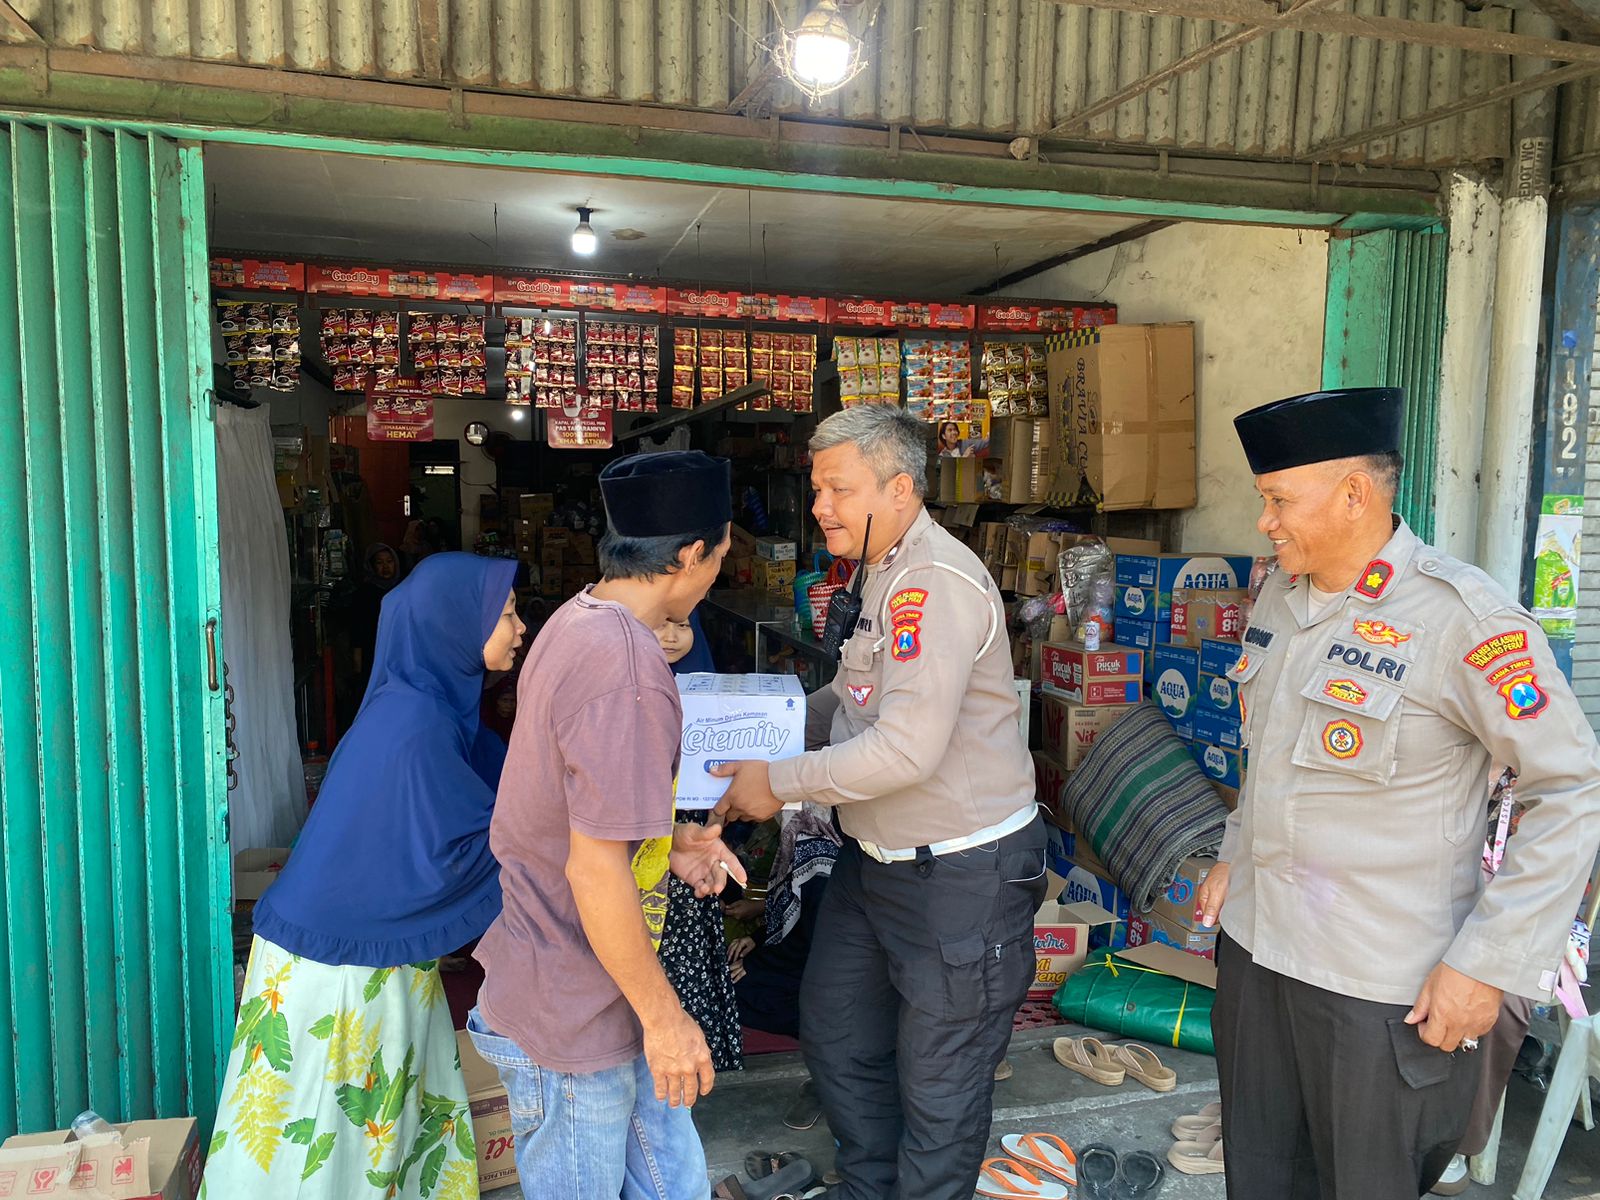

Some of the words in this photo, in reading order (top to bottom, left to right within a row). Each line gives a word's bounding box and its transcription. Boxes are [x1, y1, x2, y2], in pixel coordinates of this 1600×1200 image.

[1521, 141, 1535, 161] WC
[1519, 166, 1533, 200] EDOT
[1076, 357, 1088, 435] BRAVIA
[386, 430, 417, 439] HEMAT
[1183, 573, 1229, 589] AQUA
[1127, 592, 1142, 603] AQUA
[1174, 613, 1184, 623] 48
[1222, 609, 1239, 617] CUP
[1468, 643, 1491, 664] POLRES
[1096, 660, 1120, 672] pucuk
[1327, 643, 1406, 682] POLRI
[1491, 667, 1509, 681] JAWA
[1160, 681, 1186, 699] AQUA
[1212, 683, 1229, 697] AQUA
[685, 720, 790, 755] eternity
[1074, 728, 1098, 744] Vit
[1206, 751, 1224, 766] AQUA
[1066, 880, 1098, 905] AQUA
[1131, 920, 1143, 932] CUP
[1130, 929, 1142, 946] 48
